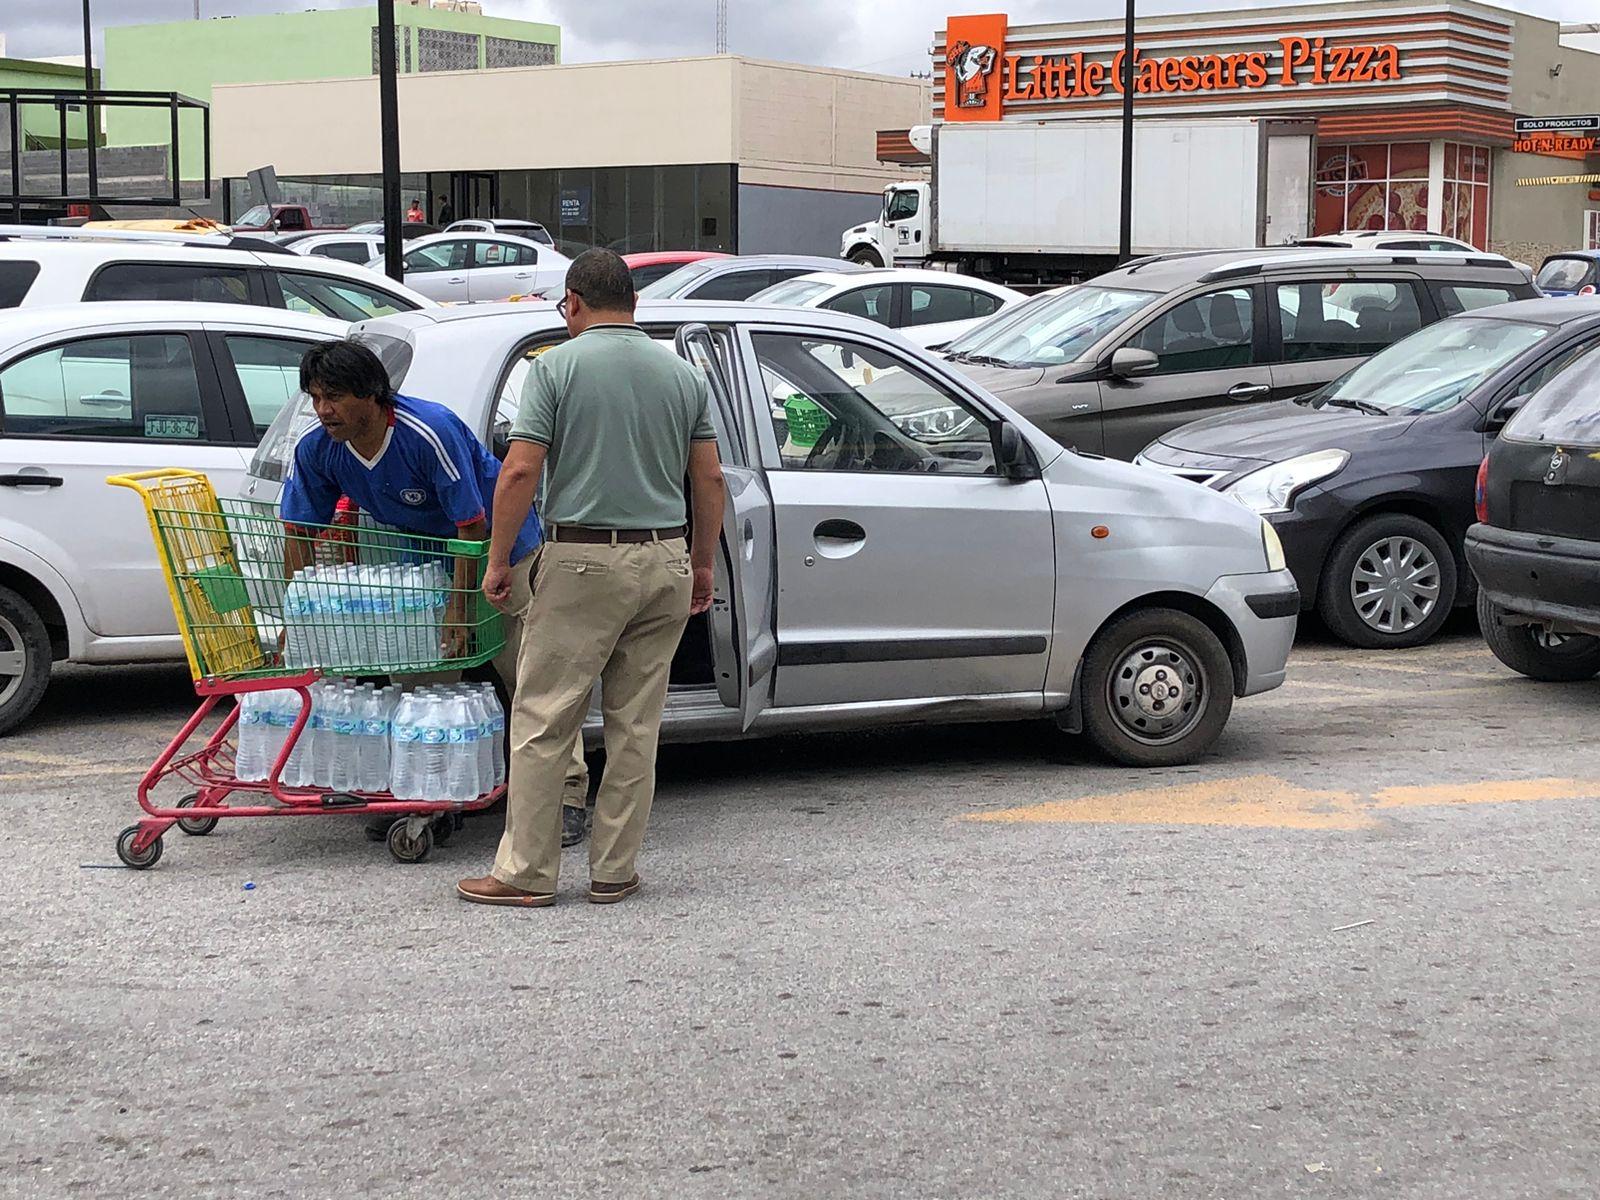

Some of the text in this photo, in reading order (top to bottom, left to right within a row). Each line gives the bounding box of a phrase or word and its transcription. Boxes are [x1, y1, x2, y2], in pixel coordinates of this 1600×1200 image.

[1003, 36, 1401, 100] Little Caesars Pizza
[1522, 119, 1592, 129] SOLO PRODUCTOS
